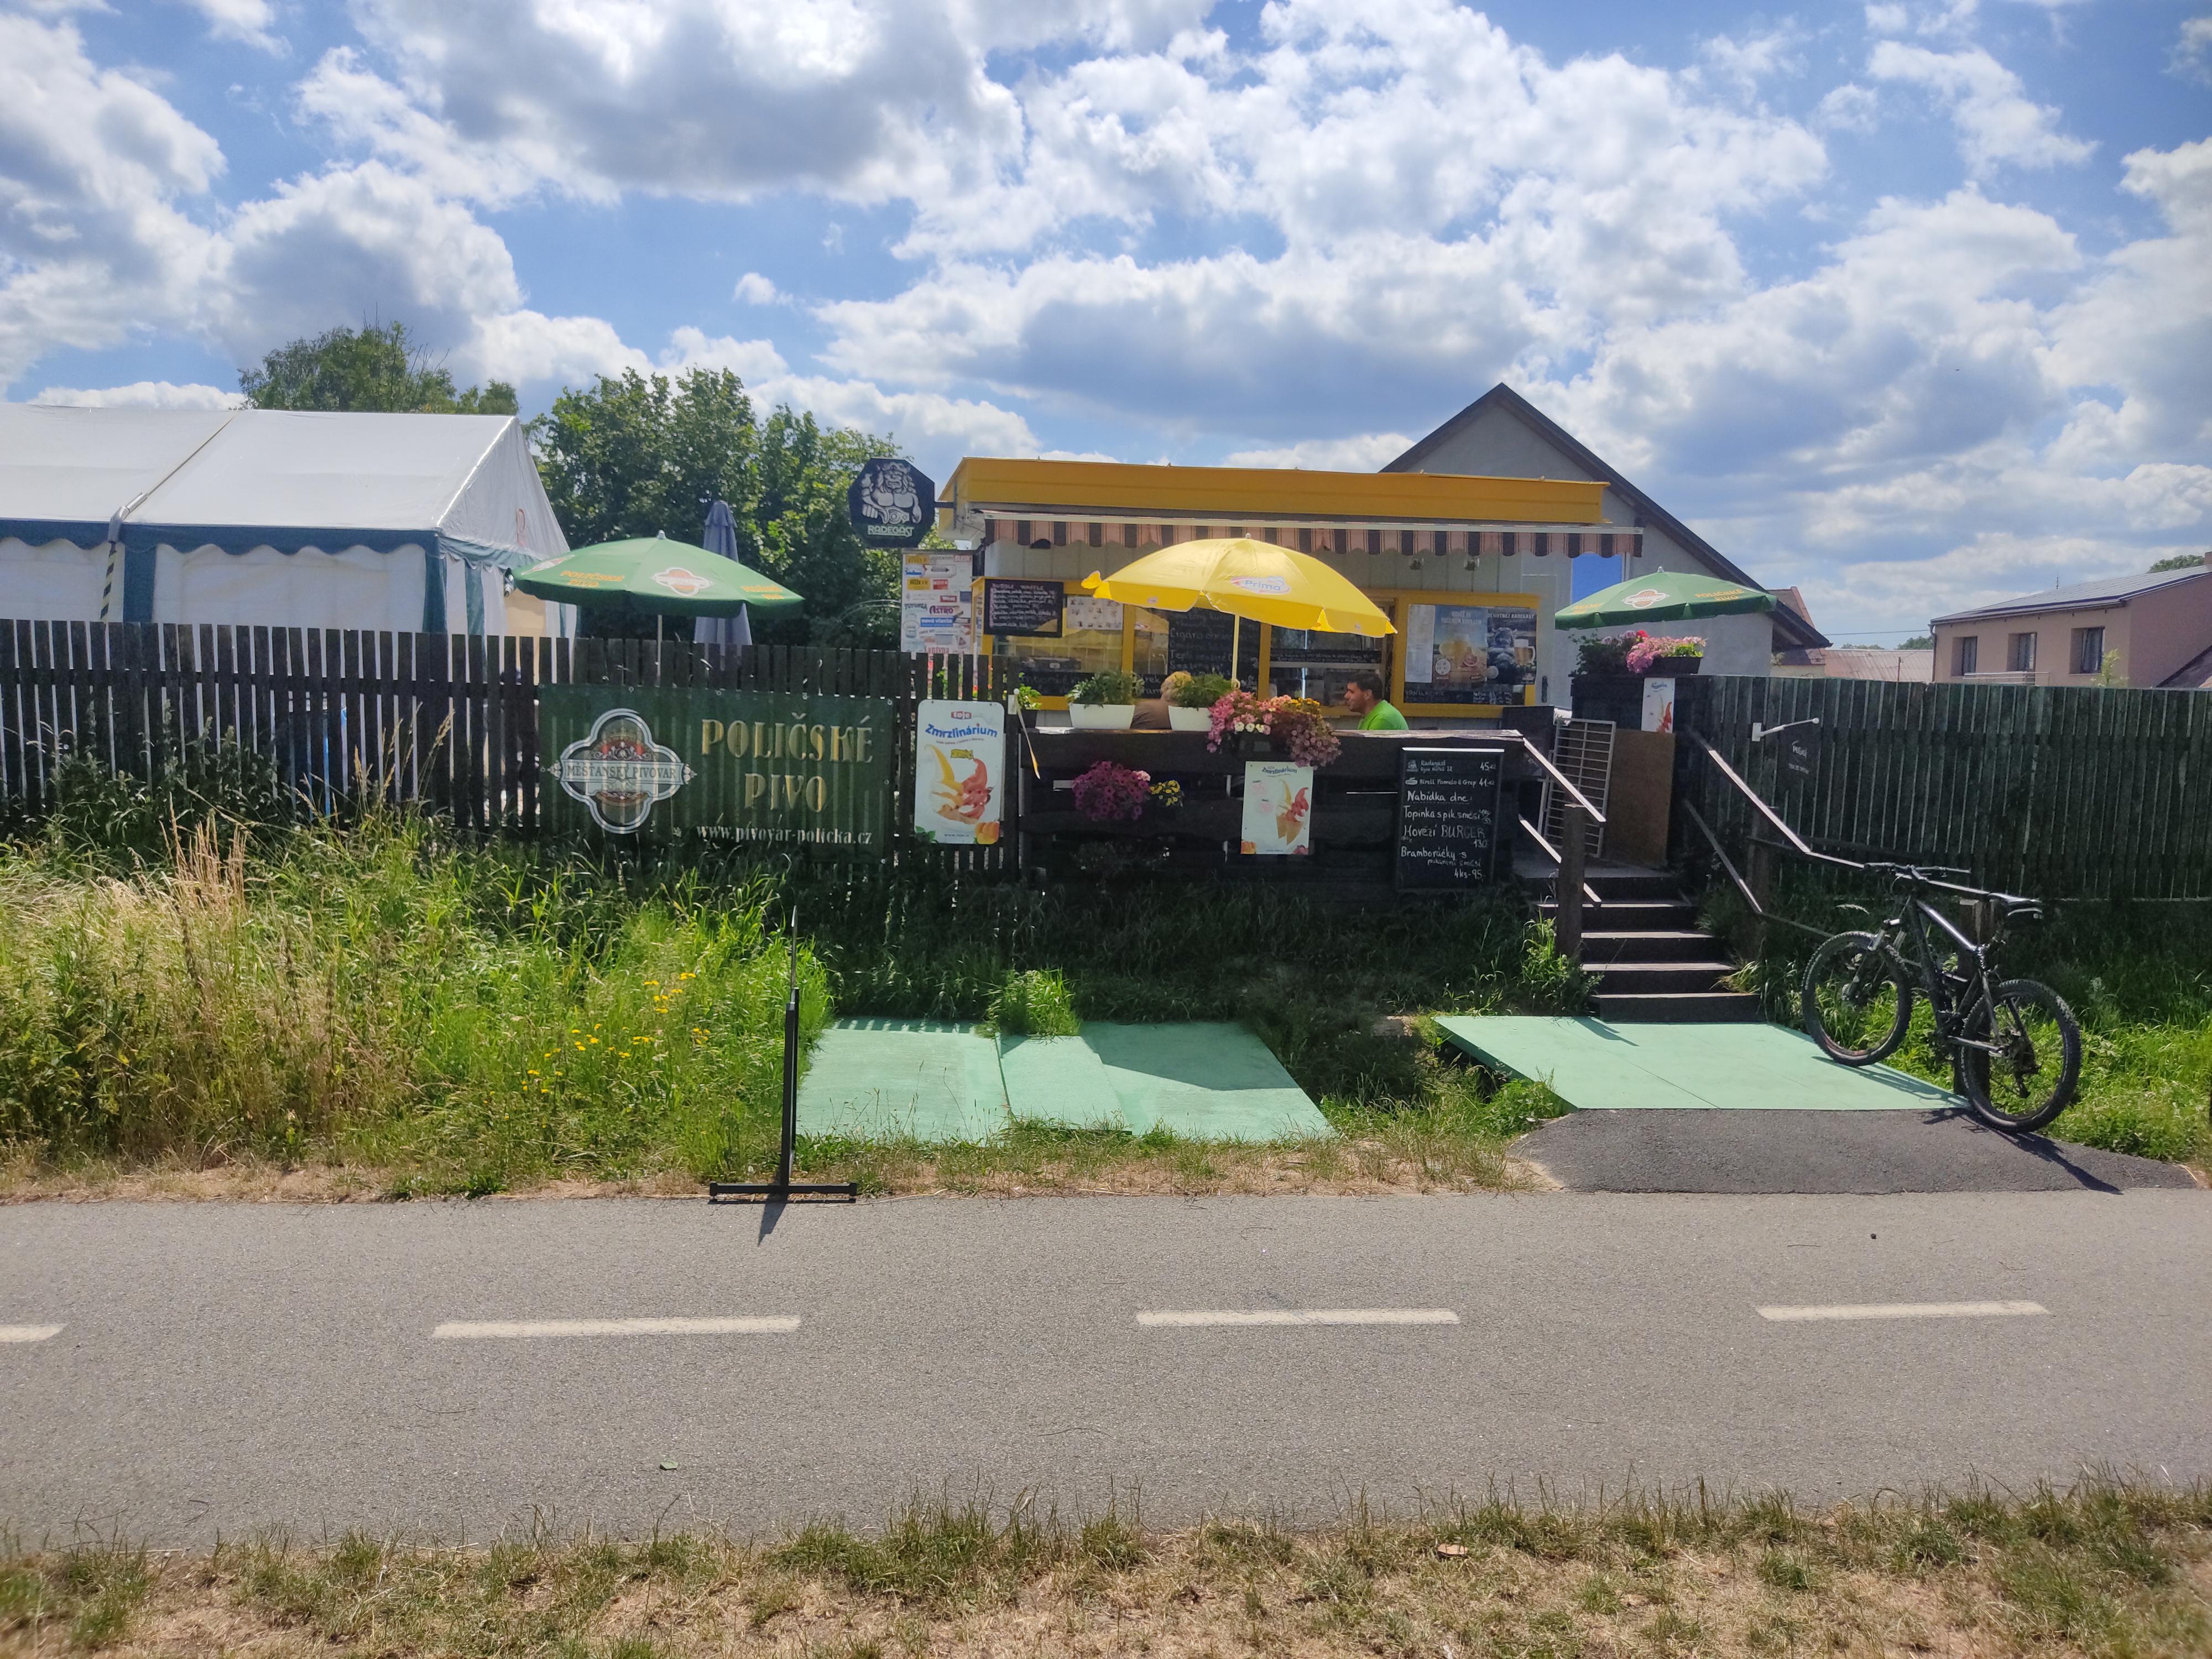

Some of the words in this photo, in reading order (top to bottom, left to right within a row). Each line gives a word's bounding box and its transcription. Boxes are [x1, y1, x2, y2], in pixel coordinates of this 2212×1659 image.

[868, 525, 915, 537] RADEGAST
[1245, 580, 1281, 591] Prima
[953, 711, 971, 719] toje
[925, 723, 998, 738] Zmrzlinárium
[702, 712, 873, 763] POLIČSKÉ
[633, 767, 676, 779] PIVOVAR
[1463, 779, 1477, 787] Grep
[745, 773, 827, 812] PIVO
[1407, 790, 1446, 801] Nabídka
[1403, 805, 1436, 821] Topinka
[1401, 846, 1455, 860] Bramboráčky
